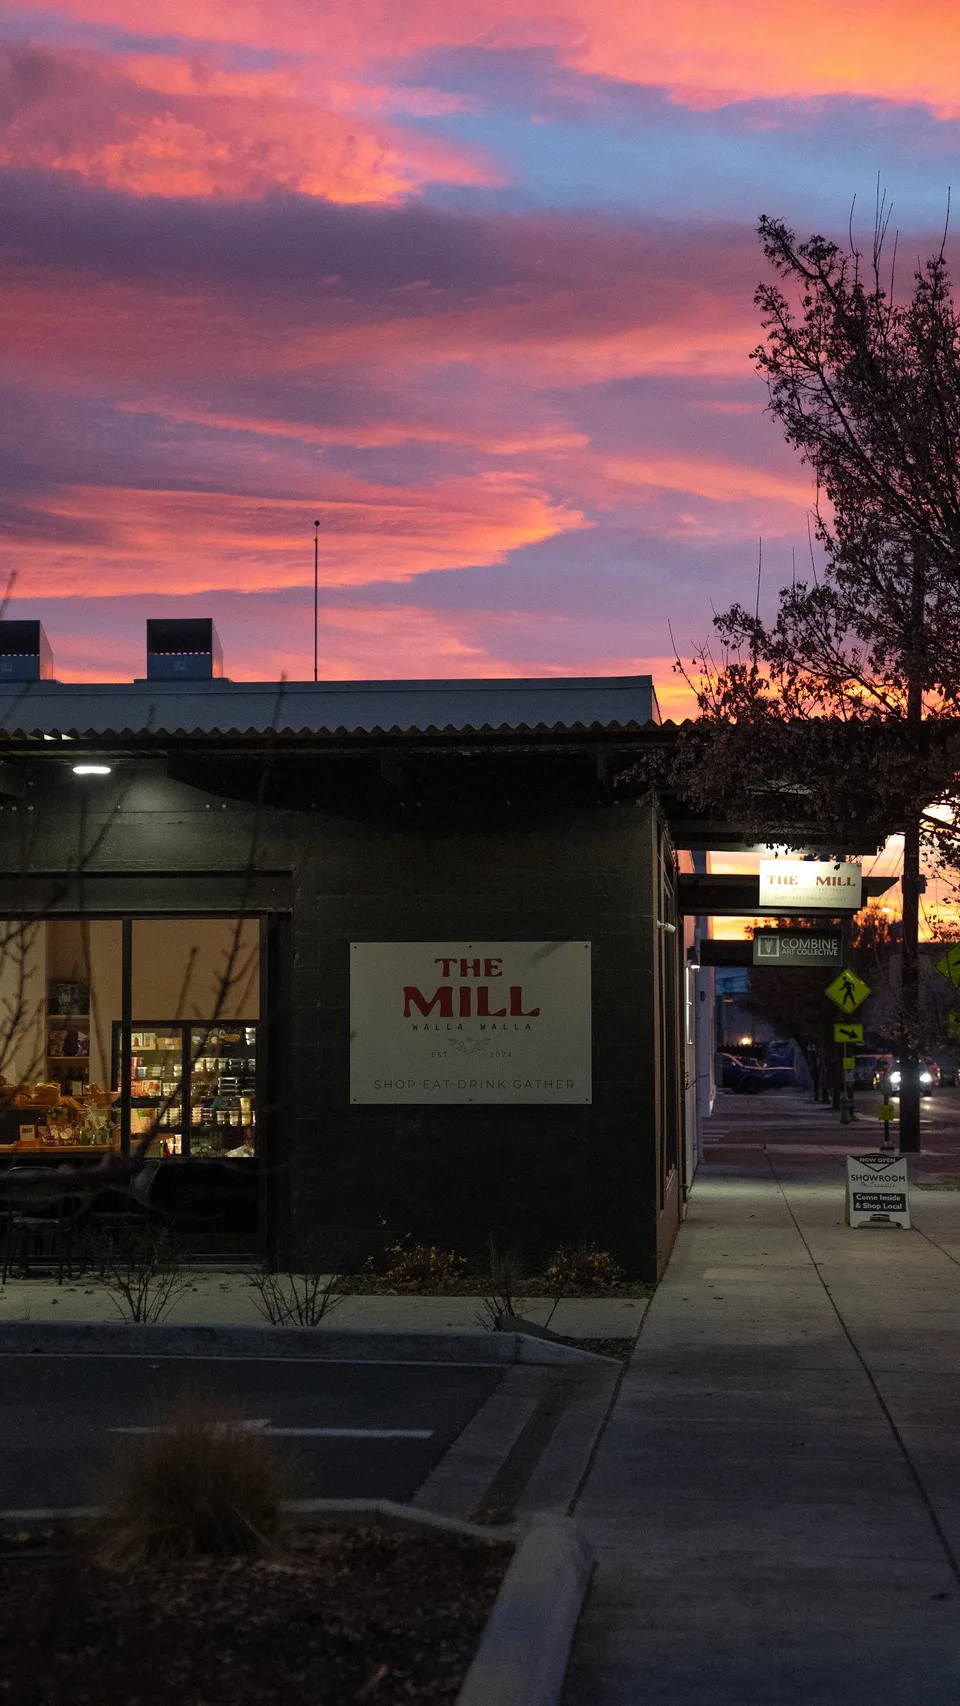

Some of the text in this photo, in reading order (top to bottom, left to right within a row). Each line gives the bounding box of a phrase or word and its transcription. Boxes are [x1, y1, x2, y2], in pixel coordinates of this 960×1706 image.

[765, 875, 856, 887] THE MILL
[781, 938, 838, 950] COMBINE
[434, 958, 503, 977] THE
[403, 986, 541, 1018] MILL
[412, 1023, 532, 1031] WALLA WALLA
[489, 1051, 513, 1059] 2024
[850, 1174, 906, 1182] SHOWROOM
[862, 1202, 882, 1210] Shop
